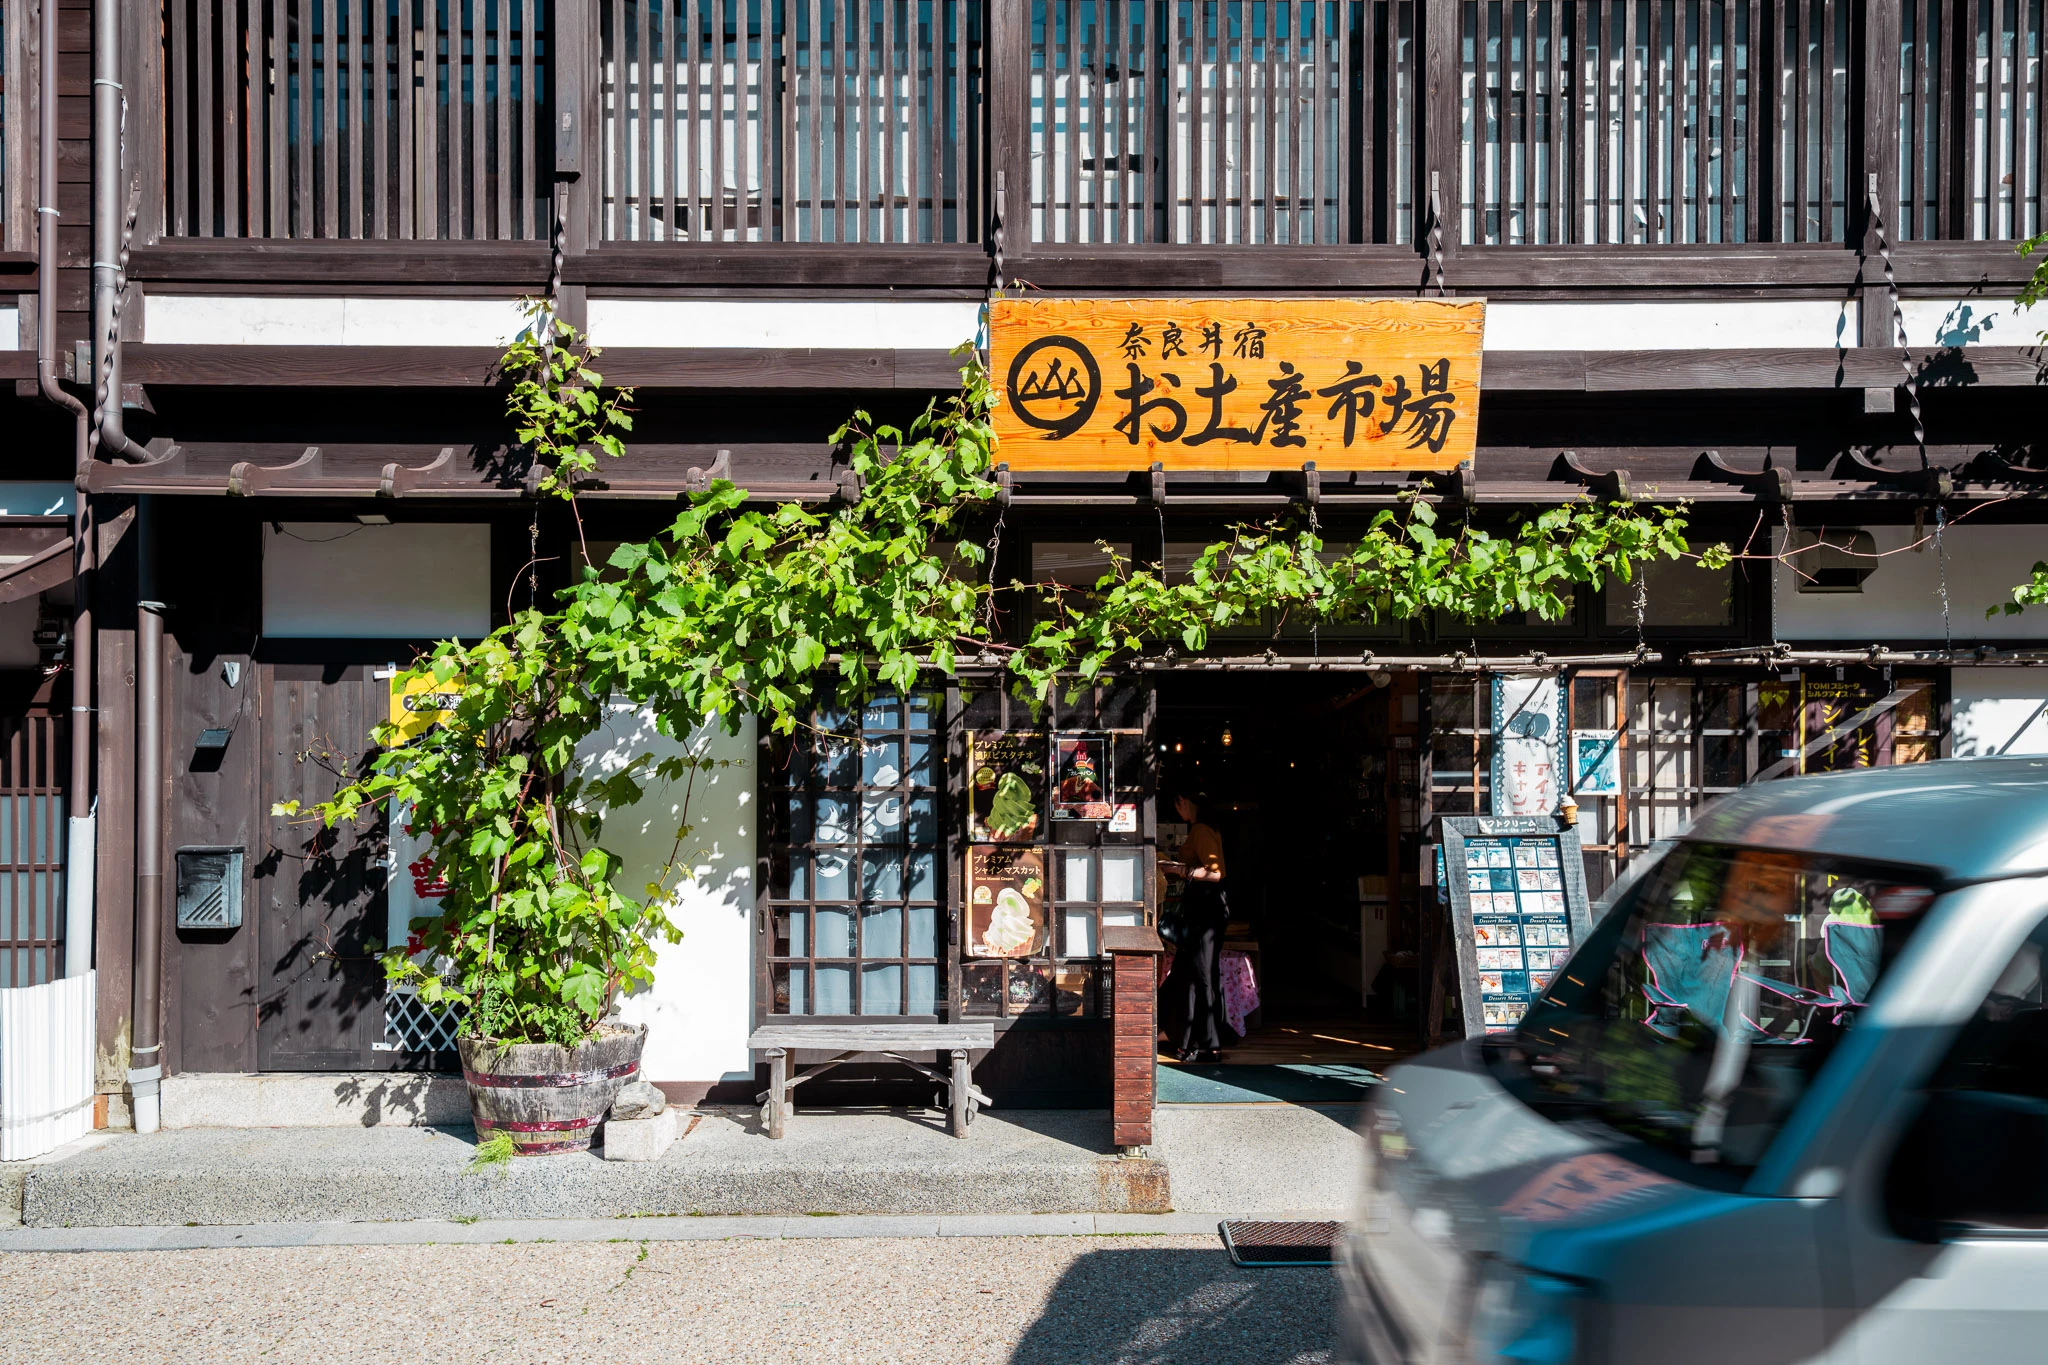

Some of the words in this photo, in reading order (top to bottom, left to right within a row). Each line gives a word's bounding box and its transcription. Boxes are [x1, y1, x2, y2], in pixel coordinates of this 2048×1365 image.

[1116, 322, 1266, 360] 奈良井宿
[1113, 358, 1456, 454] お土産市場
[975, 740, 1013, 750] プレミアム
[975, 750, 1033, 760] 濃厚ピスタチオ
[1535, 763, 1550, 812] アイス
[974, 855, 1012, 864] プレミアム
[974, 866, 1041, 875] シャインマスカット
